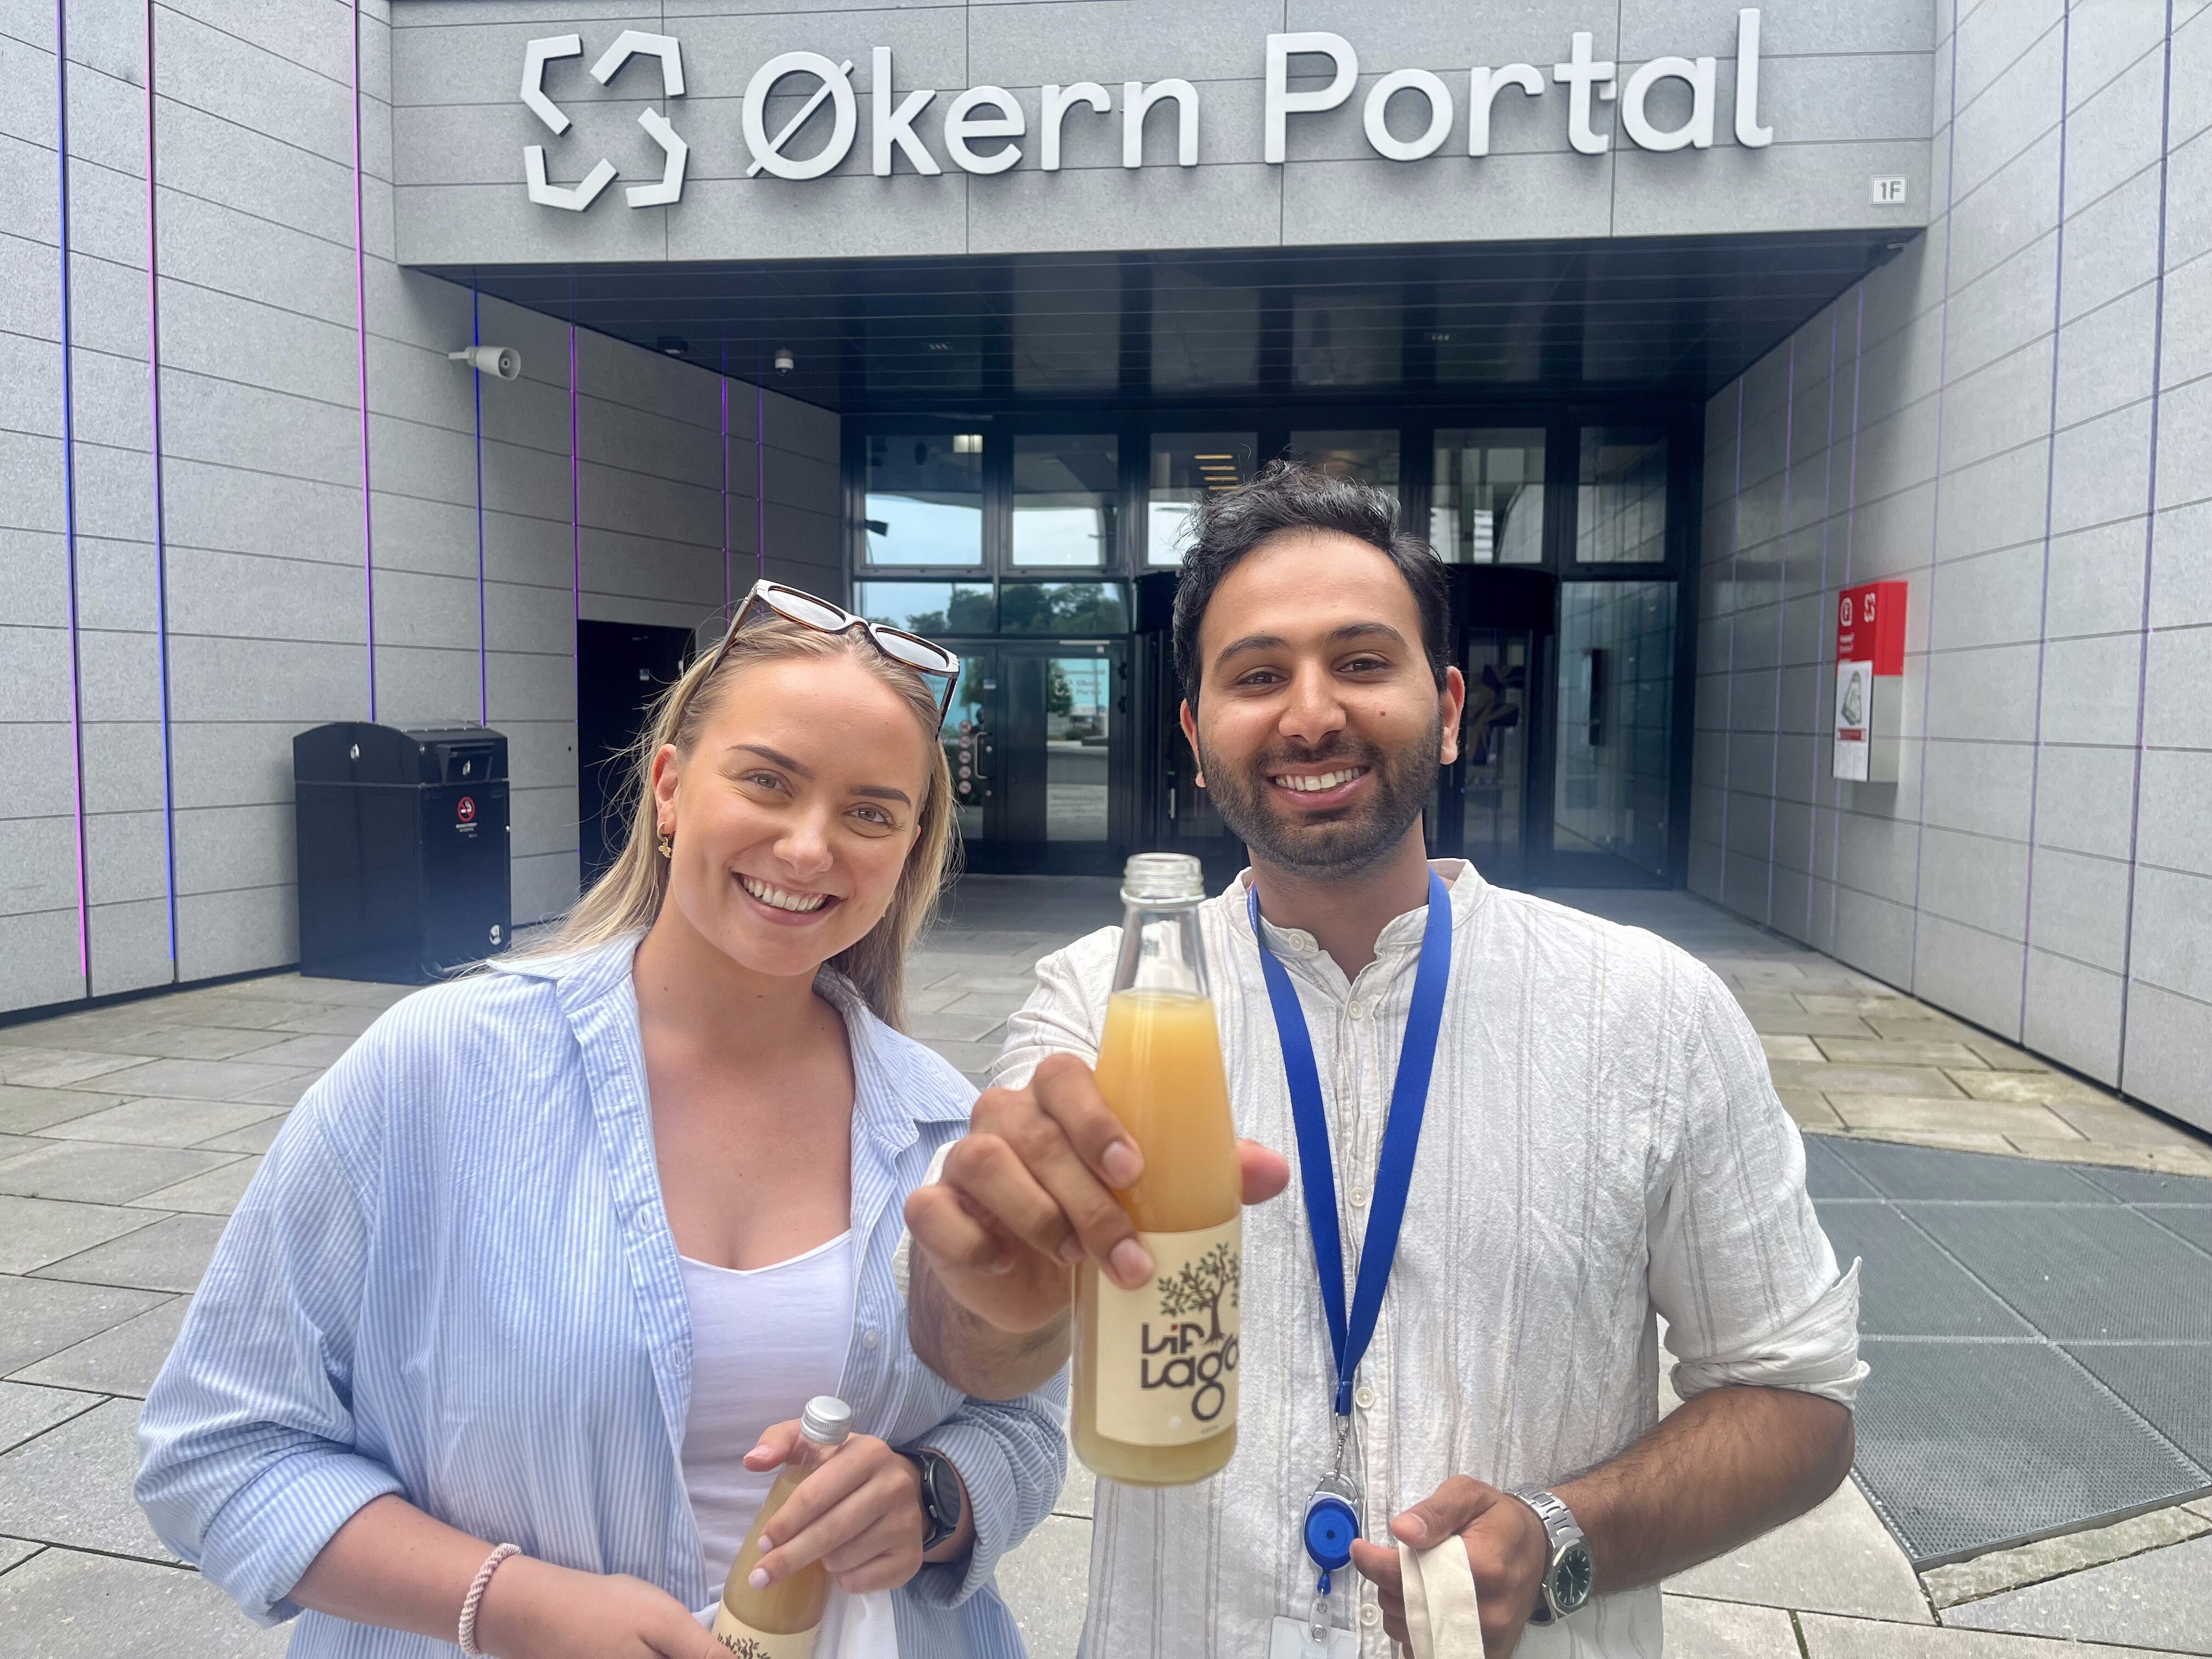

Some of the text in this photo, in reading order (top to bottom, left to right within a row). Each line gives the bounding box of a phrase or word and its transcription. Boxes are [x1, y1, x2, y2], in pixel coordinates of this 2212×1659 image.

[742, 8, 1774, 180] Økern Portal
[1880, 181, 1901, 201] 1F
